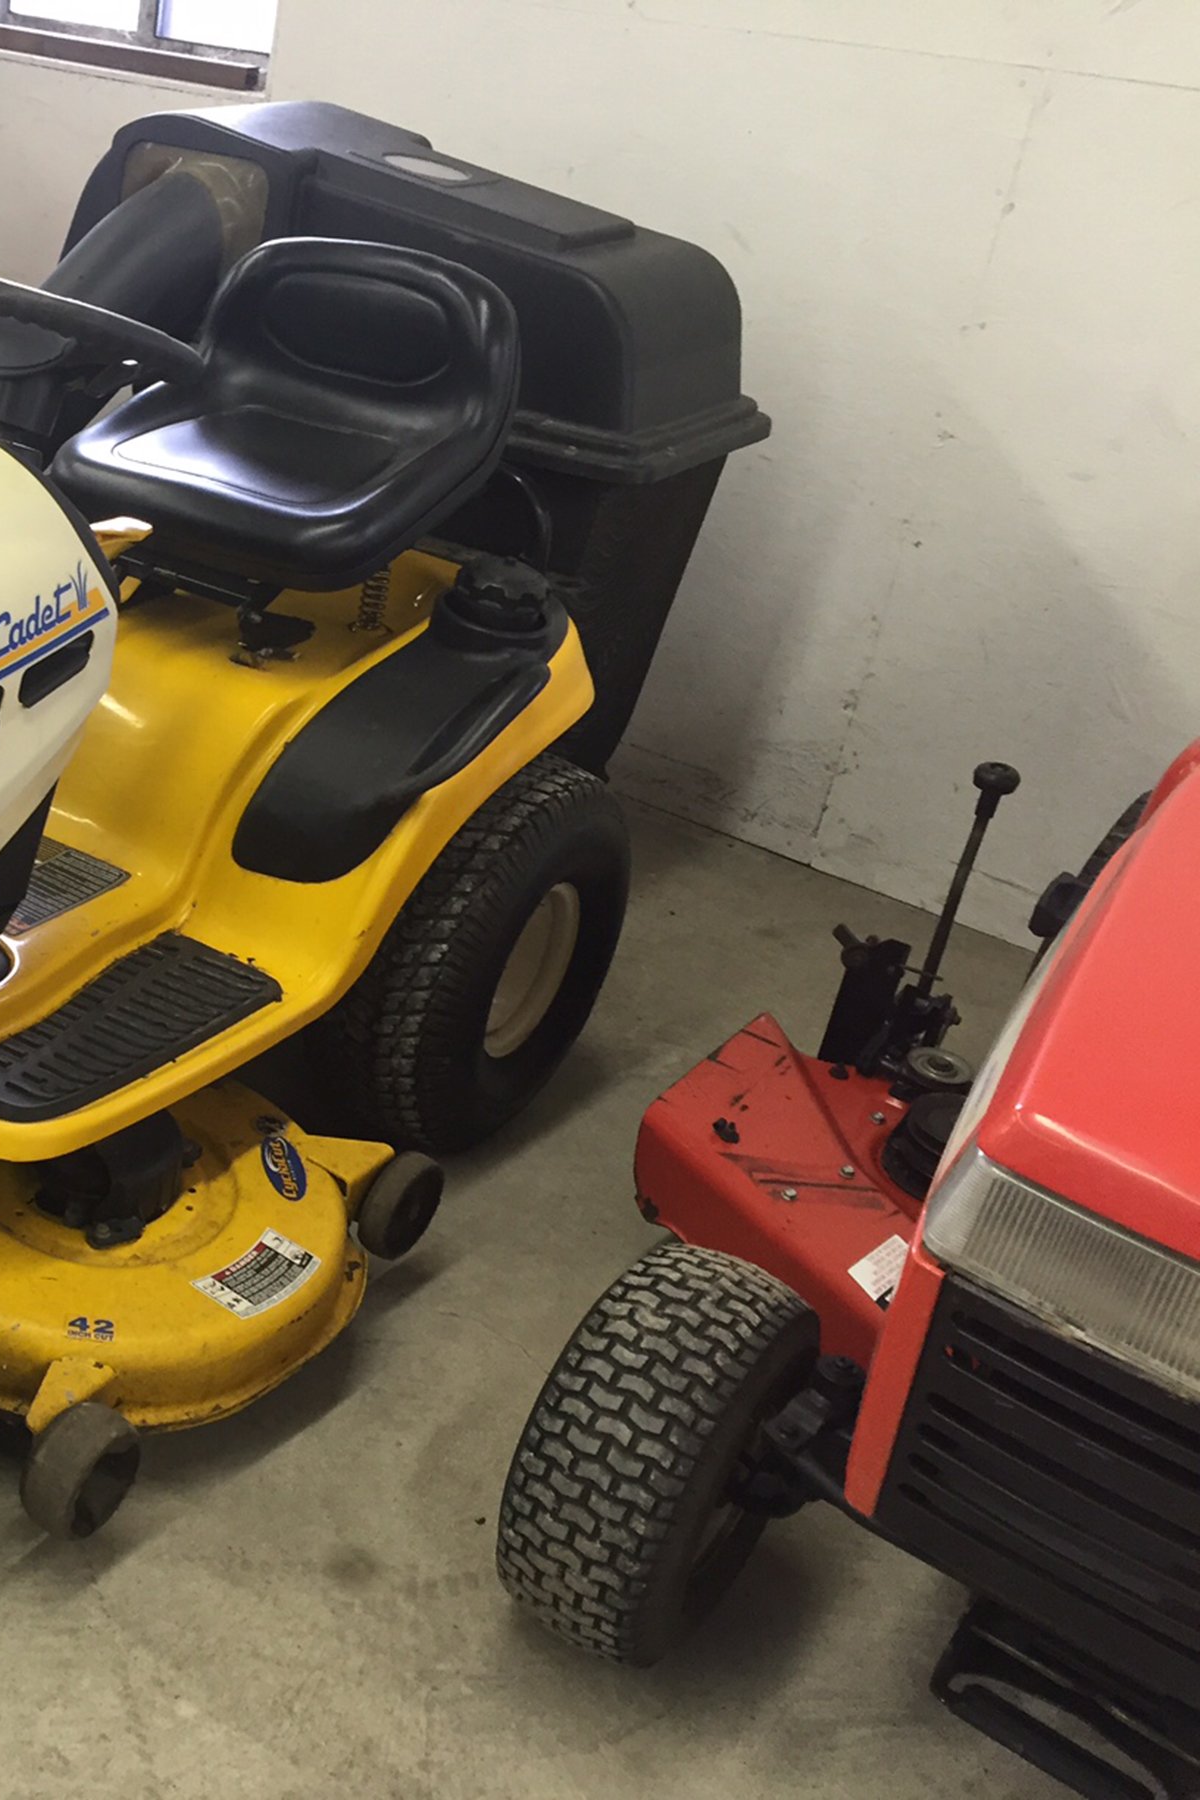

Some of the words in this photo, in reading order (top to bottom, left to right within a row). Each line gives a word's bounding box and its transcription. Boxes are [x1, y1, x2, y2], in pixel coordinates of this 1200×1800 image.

[68, 1316, 115, 1335] 42
[67, 1329, 92, 1339] INCH
[93, 1333, 114, 1342] CUT
